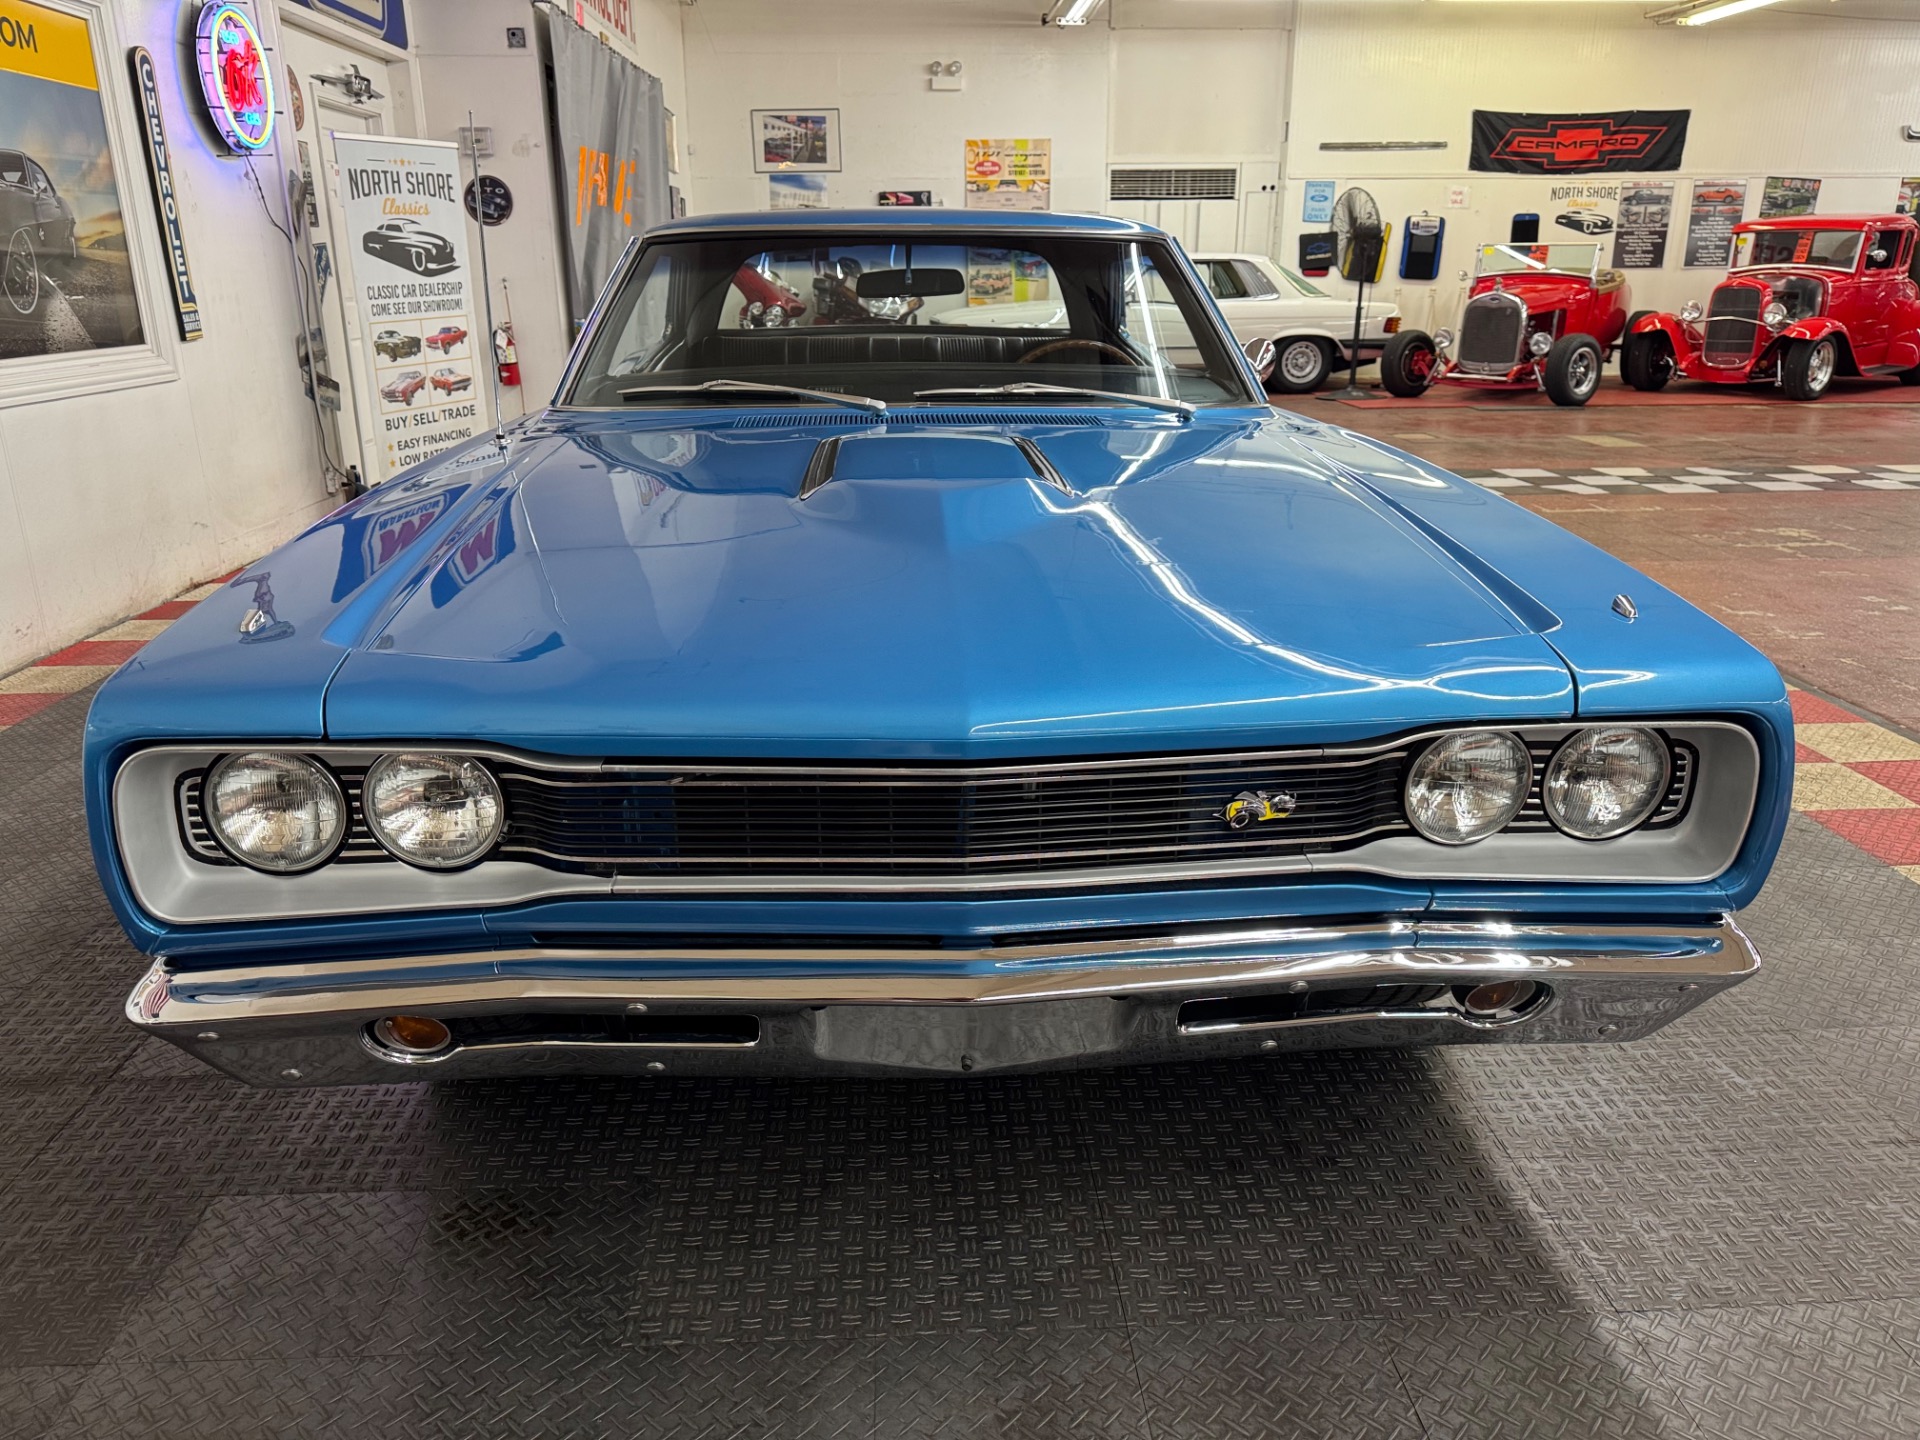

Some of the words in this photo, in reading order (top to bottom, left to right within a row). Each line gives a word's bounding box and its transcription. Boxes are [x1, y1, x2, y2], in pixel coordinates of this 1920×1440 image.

[0, 16, 38, 53] OM
[1516, 136, 1639, 150] CAMARO
[142, 62, 190, 298] CHEVROLET
[347, 168, 402, 201] NORTH
[405, 171, 456, 203] SHORE
[1550, 187, 1583, 201] NORTH
[1586, 186, 1619, 201] SHORE
[382, 197, 431, 216] Classics
[367, 284, 400, 300] CLASSIC
[401, 283, 417, 298] CAR
[418, 281, 463, 298] DEALERSHIP
[371, 303, 391, 316] COME
[393, 302, 406, 315] SEE
[408, 301, 422, 314] OUR
[423, 297, 463, 313] SHOWROOM!
[397, 437, 421, 451] EASY
[423, 428, 472, 446] FINANCING
[399, 453, 421, 467] LOW
